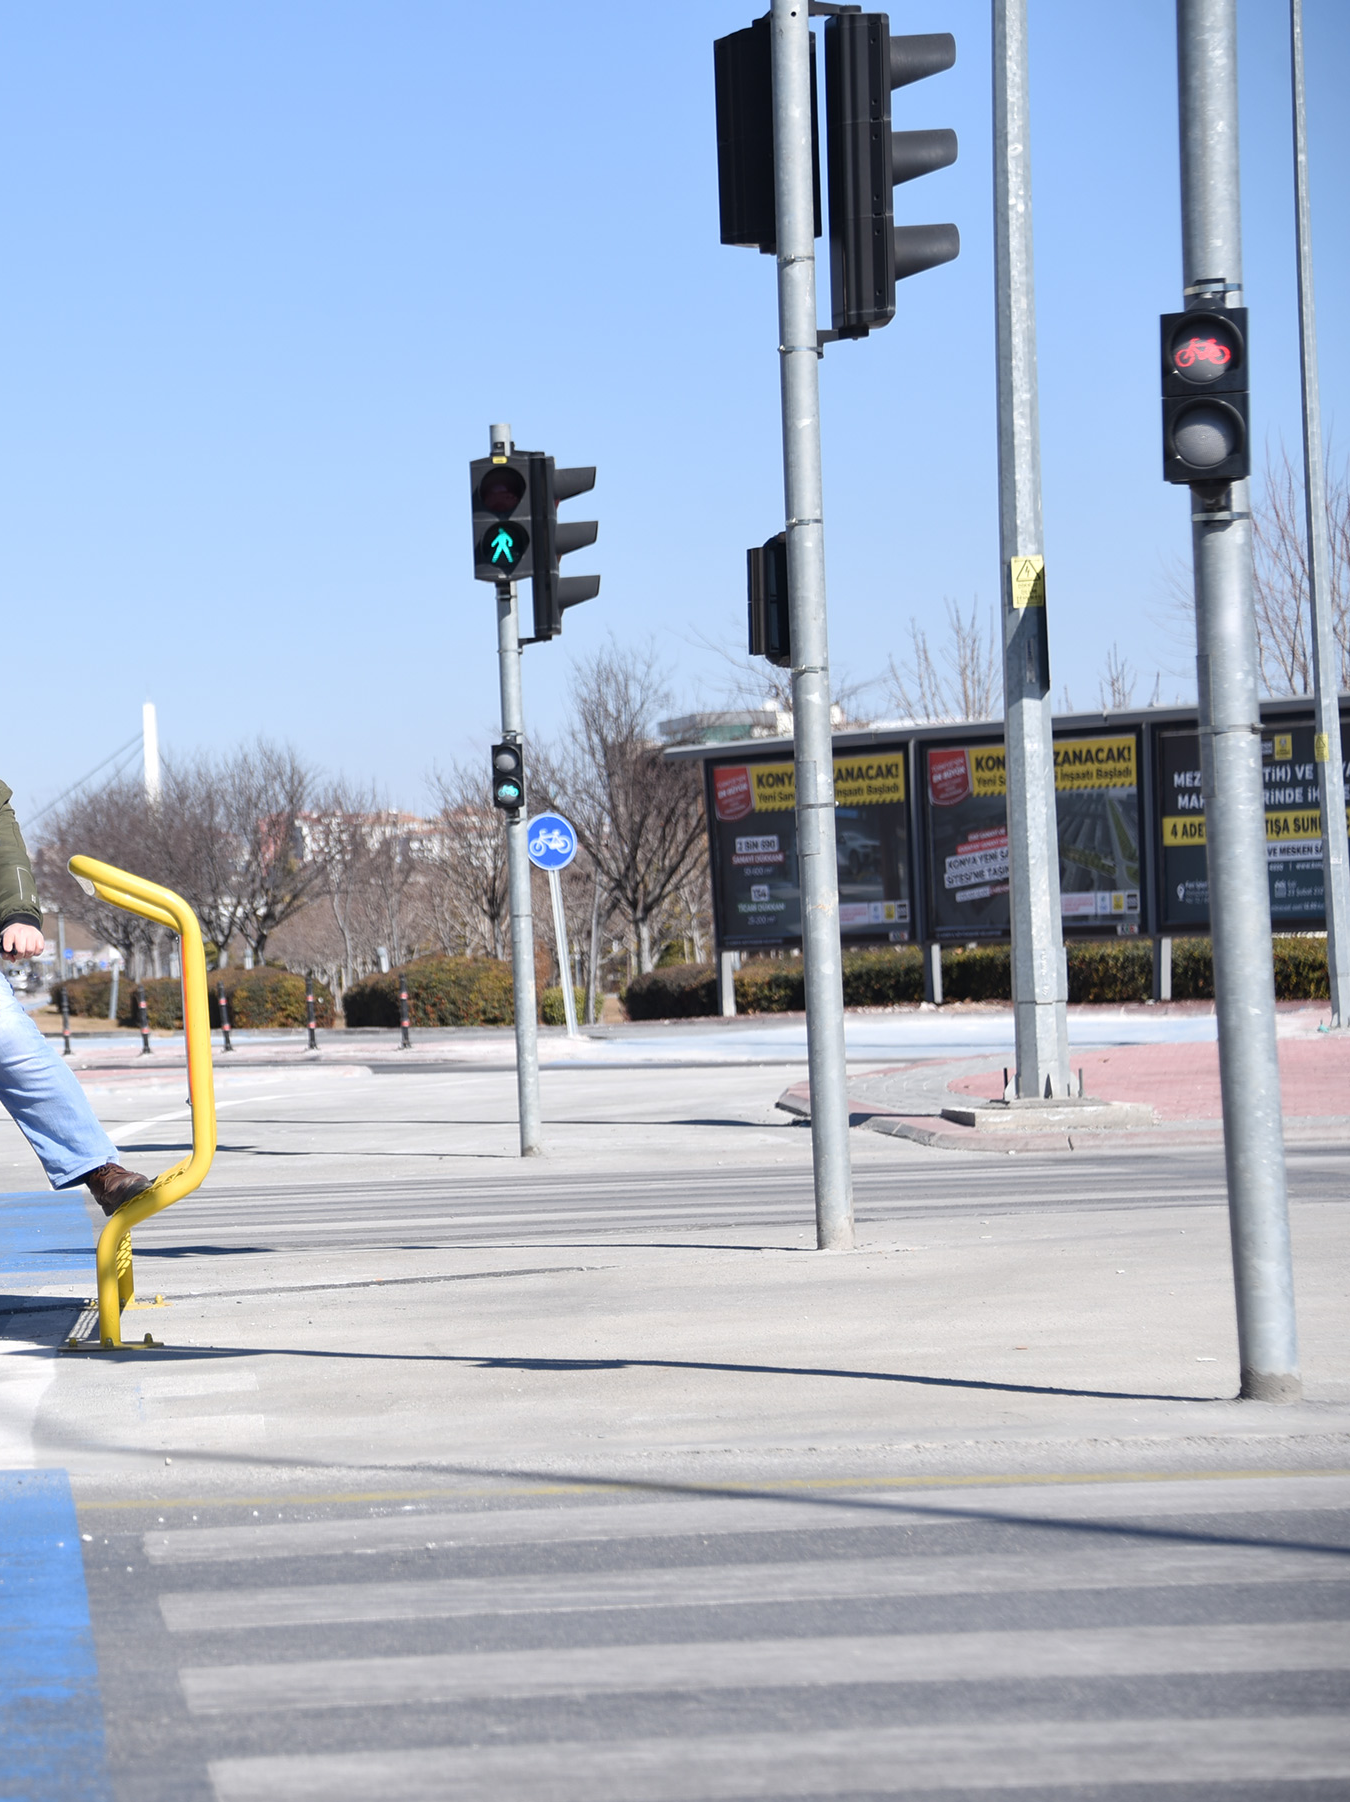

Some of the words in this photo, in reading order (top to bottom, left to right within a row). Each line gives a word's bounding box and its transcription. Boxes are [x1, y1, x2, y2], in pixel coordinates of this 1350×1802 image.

[975, 754, 1006, 773] KON
[1053, 745, 1132, 767] ZANACAK!
[756, 771, 795, 790] KONY
[834, 763, 899, 785] ANACAK!
[976, 775, 997, 788] Yeni
[1096, 765, 1132, 781] Başladı
[1173, 770, 1202, 788] MEZ
[1263, 764, 1291, 783] TİH)
[1295, 763, 1314, 781] VE
[757, 791, 777, 804] Yeni
[778, 791, 796, 803] San
[866, 782, 900, 798] Başladı
[1263, 786, 1304, 805] RİNDE
[1170, 822, 1178, 839] 4
[1181, 821, 1207, 839] ADE
[1265, 817, 1291, 838] TIŞA
[1279, 844, 1313, 857] MESKEN
